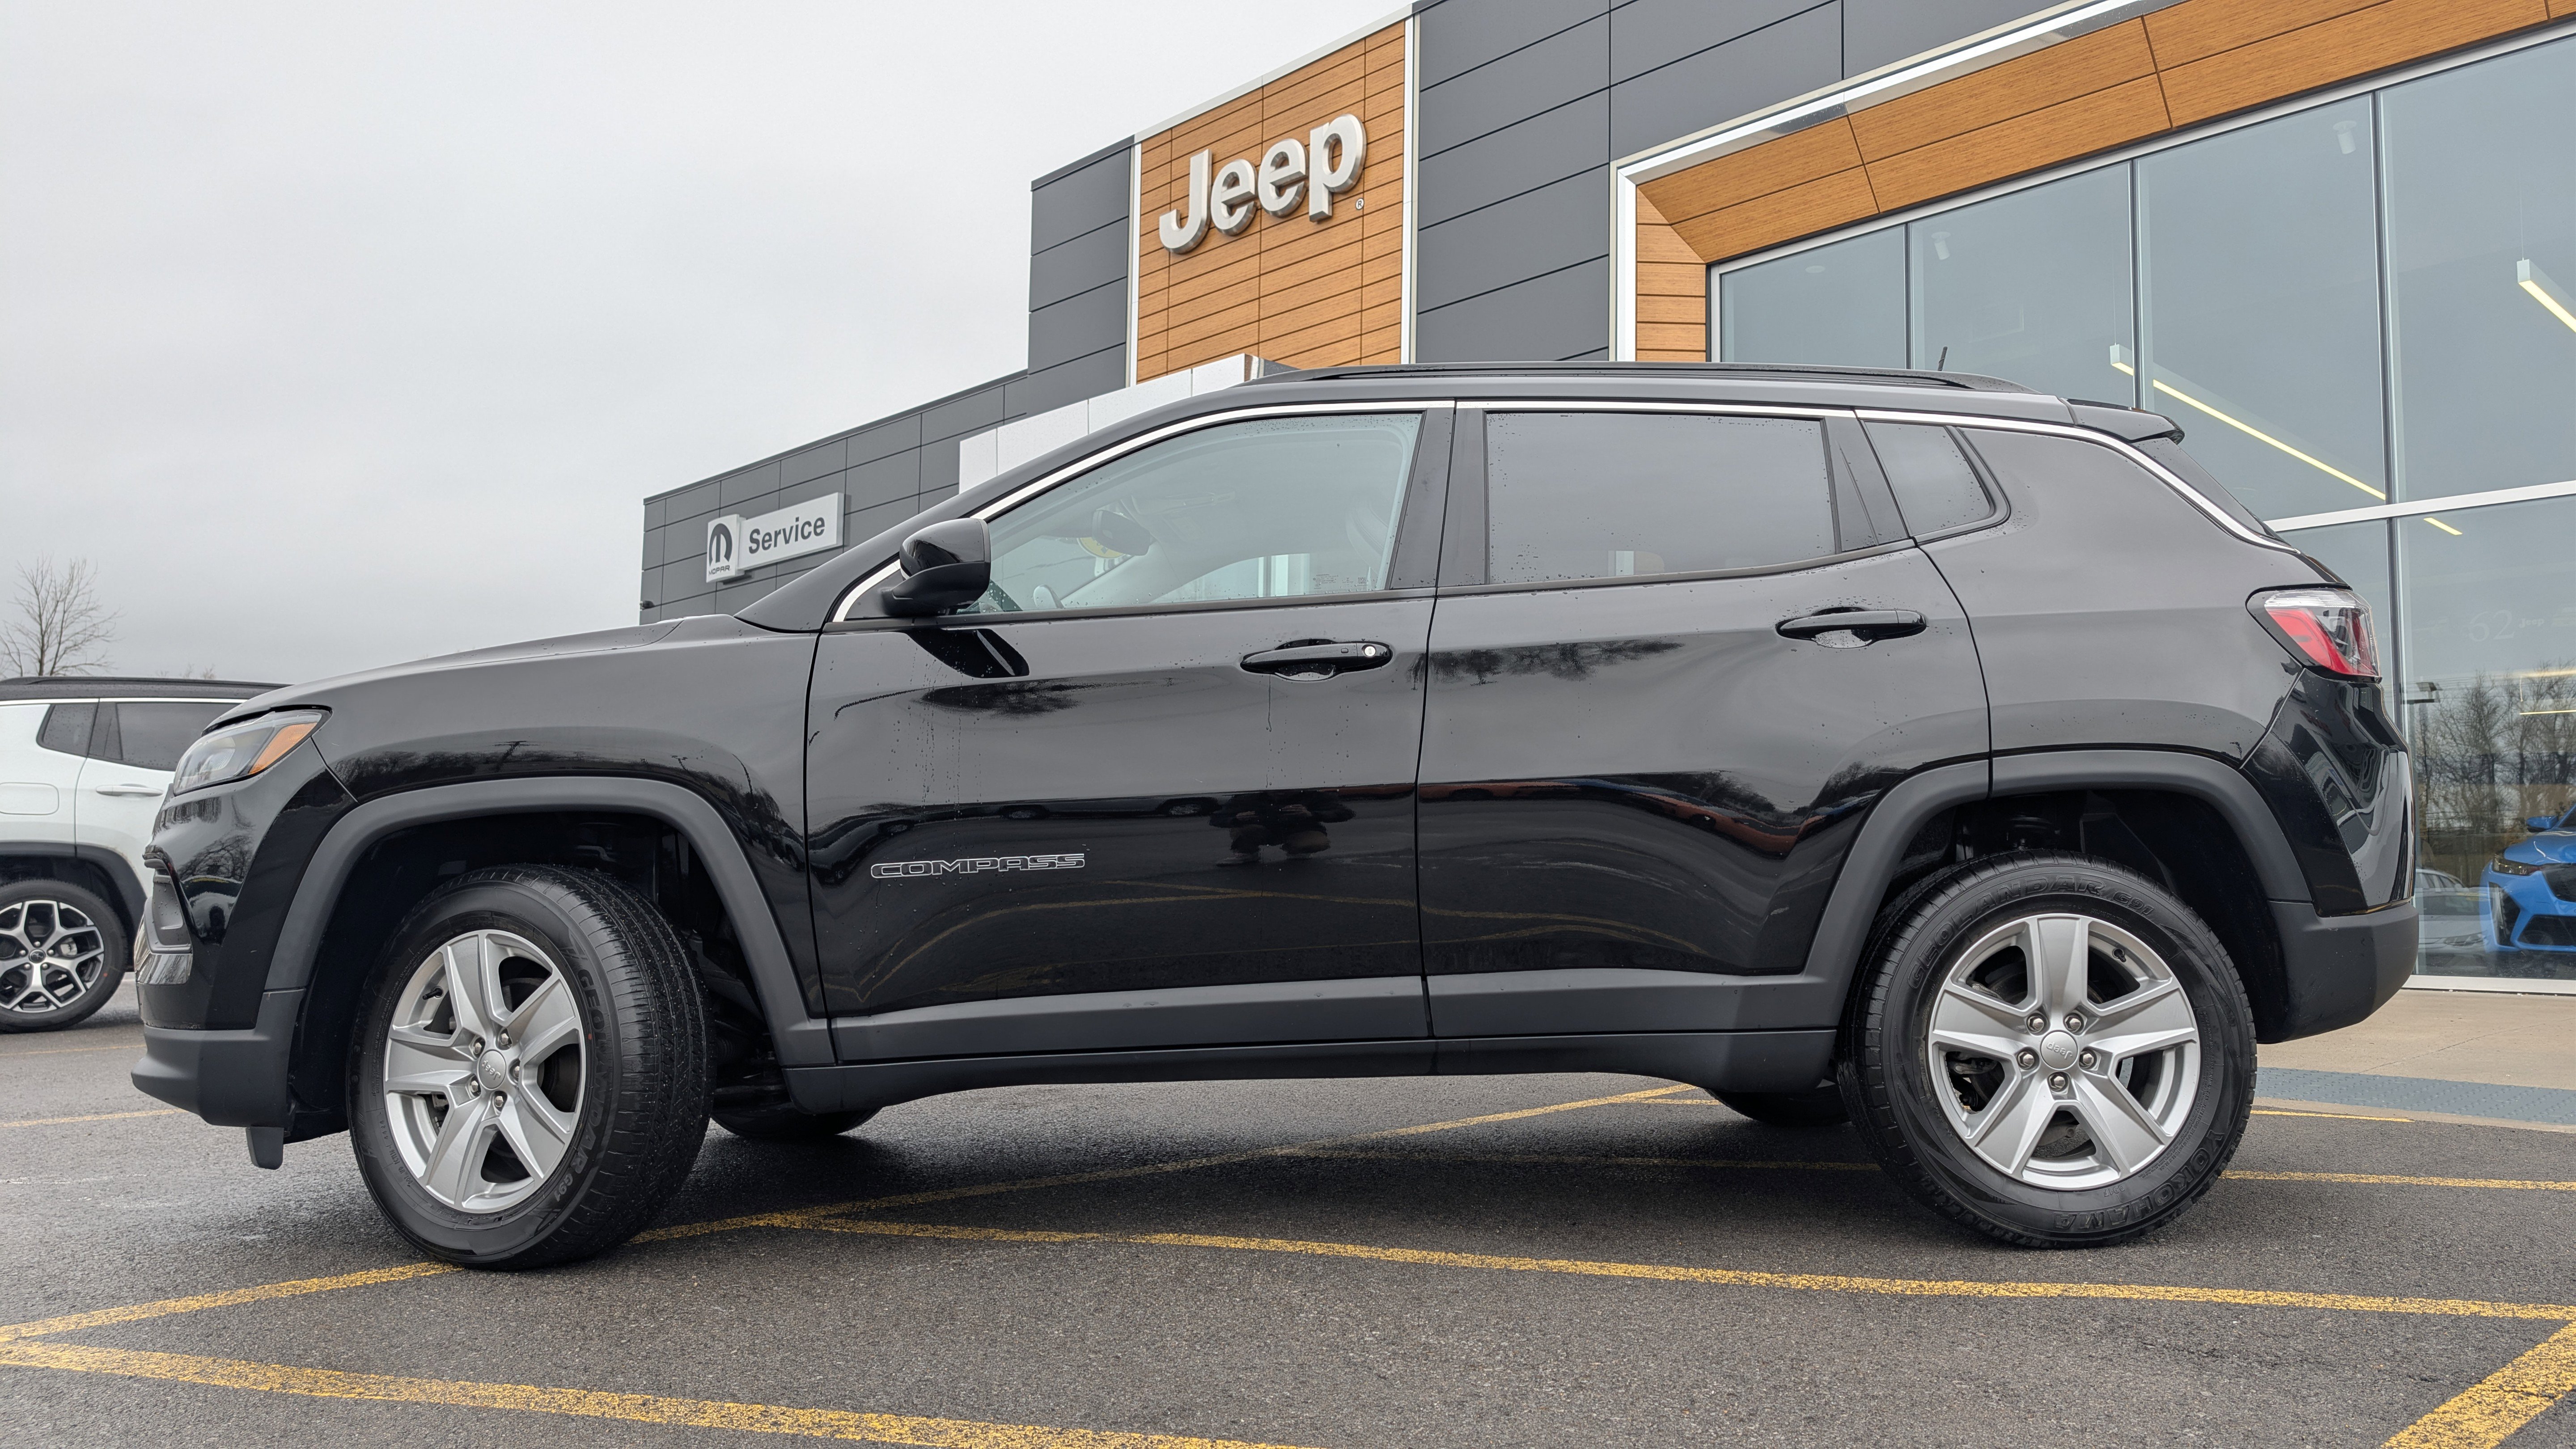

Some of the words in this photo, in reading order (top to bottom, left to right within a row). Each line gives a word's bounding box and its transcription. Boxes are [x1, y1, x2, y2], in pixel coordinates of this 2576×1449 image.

[1159, 114, 1367, 254] Jeep
[748, 516, 826, 554] Service
[708, 565, 730, 576] MOPAR
[870, 853, 1085, 879] COMPASS
[1907, 874, 2106, 989] GEOLANDAR
[2113, 891, 2155, 917] G91
[2046, 1042, 2073, 1060] Jeep
[554, 1173, 573, 1202] G91
[2053, 1129, 2225, 1230] YOKOHAMA
[2104, 1184, 2126, 1197] G91F
